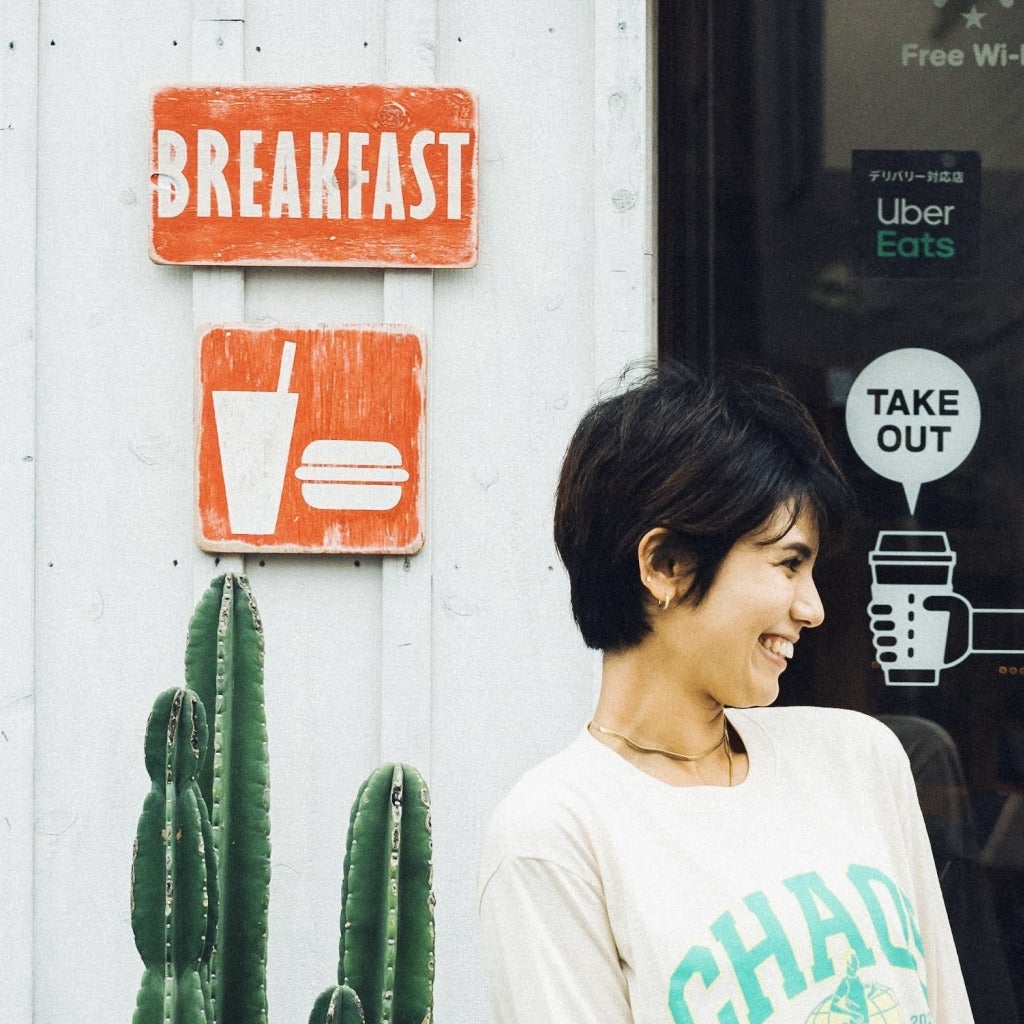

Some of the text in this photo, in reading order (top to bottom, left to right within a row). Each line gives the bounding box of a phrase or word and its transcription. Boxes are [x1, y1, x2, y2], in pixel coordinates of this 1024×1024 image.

[901, 43, 965, 67] Free
[155, 129, 471, 221] BREAKFAST
[869, 170, 964, 183] デリバリー対応店
[877, 198, 955, 225] Uber
[877, 230, 955, 258] Eats
[867, 389, 960, 416] TAKE
[877, 424, 951, 452] OUT
